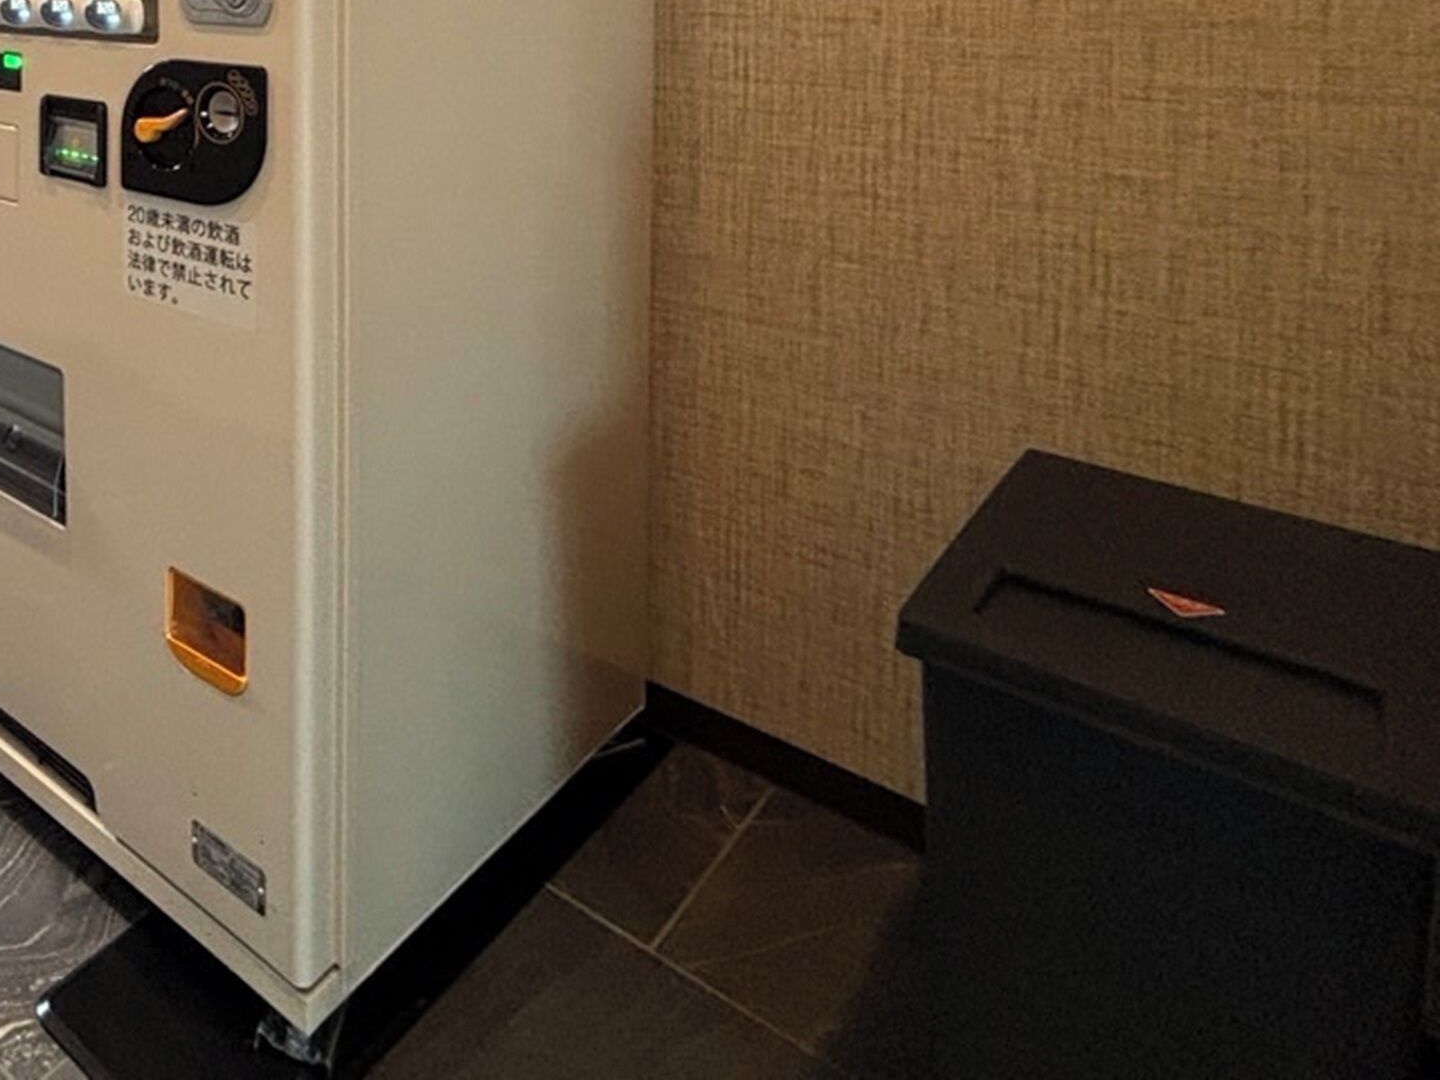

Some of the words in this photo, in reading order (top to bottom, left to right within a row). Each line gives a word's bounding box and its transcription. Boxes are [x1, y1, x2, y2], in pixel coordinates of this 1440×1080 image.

[127, 204, 240, 246] 20歳未満の飲酒
[127, 229, 252, 273] および飲酒運転は
[127, 249, 252, 300] 法律で禁止されて
[127, 275, 178, 305] います。
